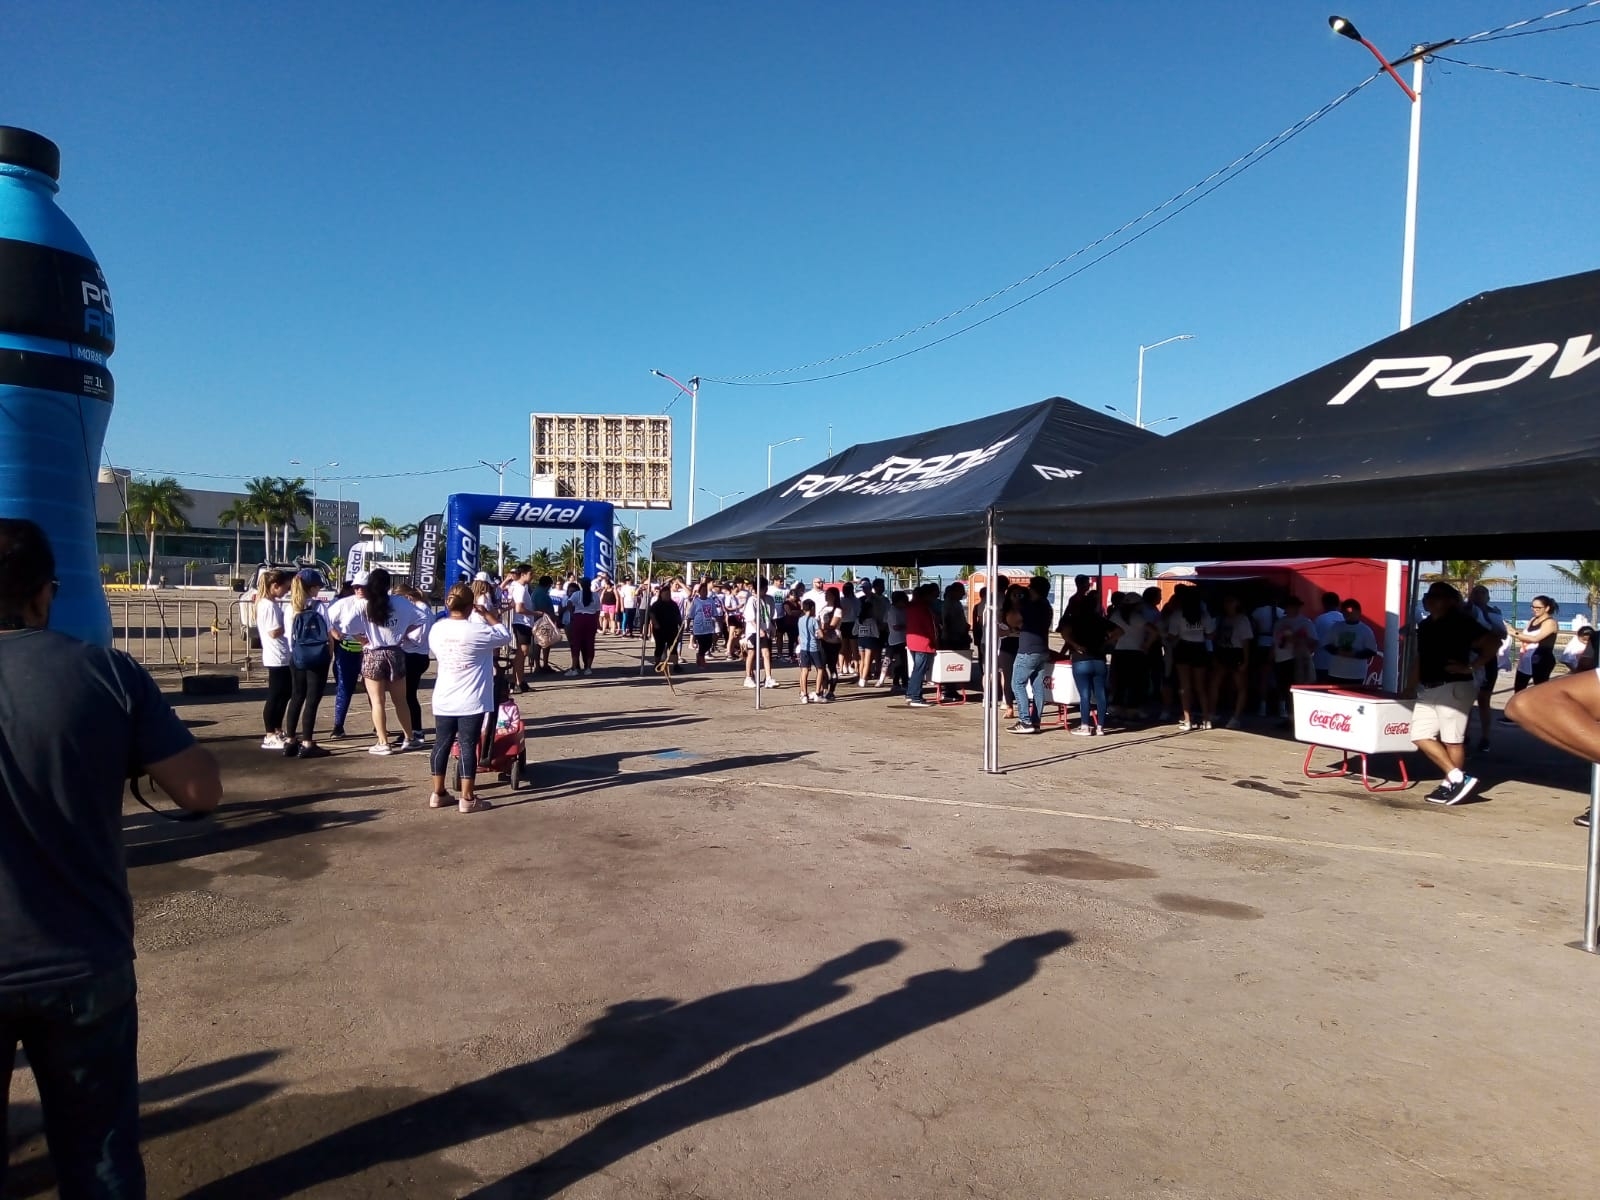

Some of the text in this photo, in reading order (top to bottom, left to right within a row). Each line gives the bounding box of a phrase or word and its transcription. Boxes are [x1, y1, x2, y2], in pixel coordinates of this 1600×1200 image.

[780, 434, 1019, 498] POWRADE
[514, 502, 584, 524] telcel
[348, 550, 362, 579] istal
[420, 524, 438, 593] POWERADE
[594, 531, 613, 583] lcel
